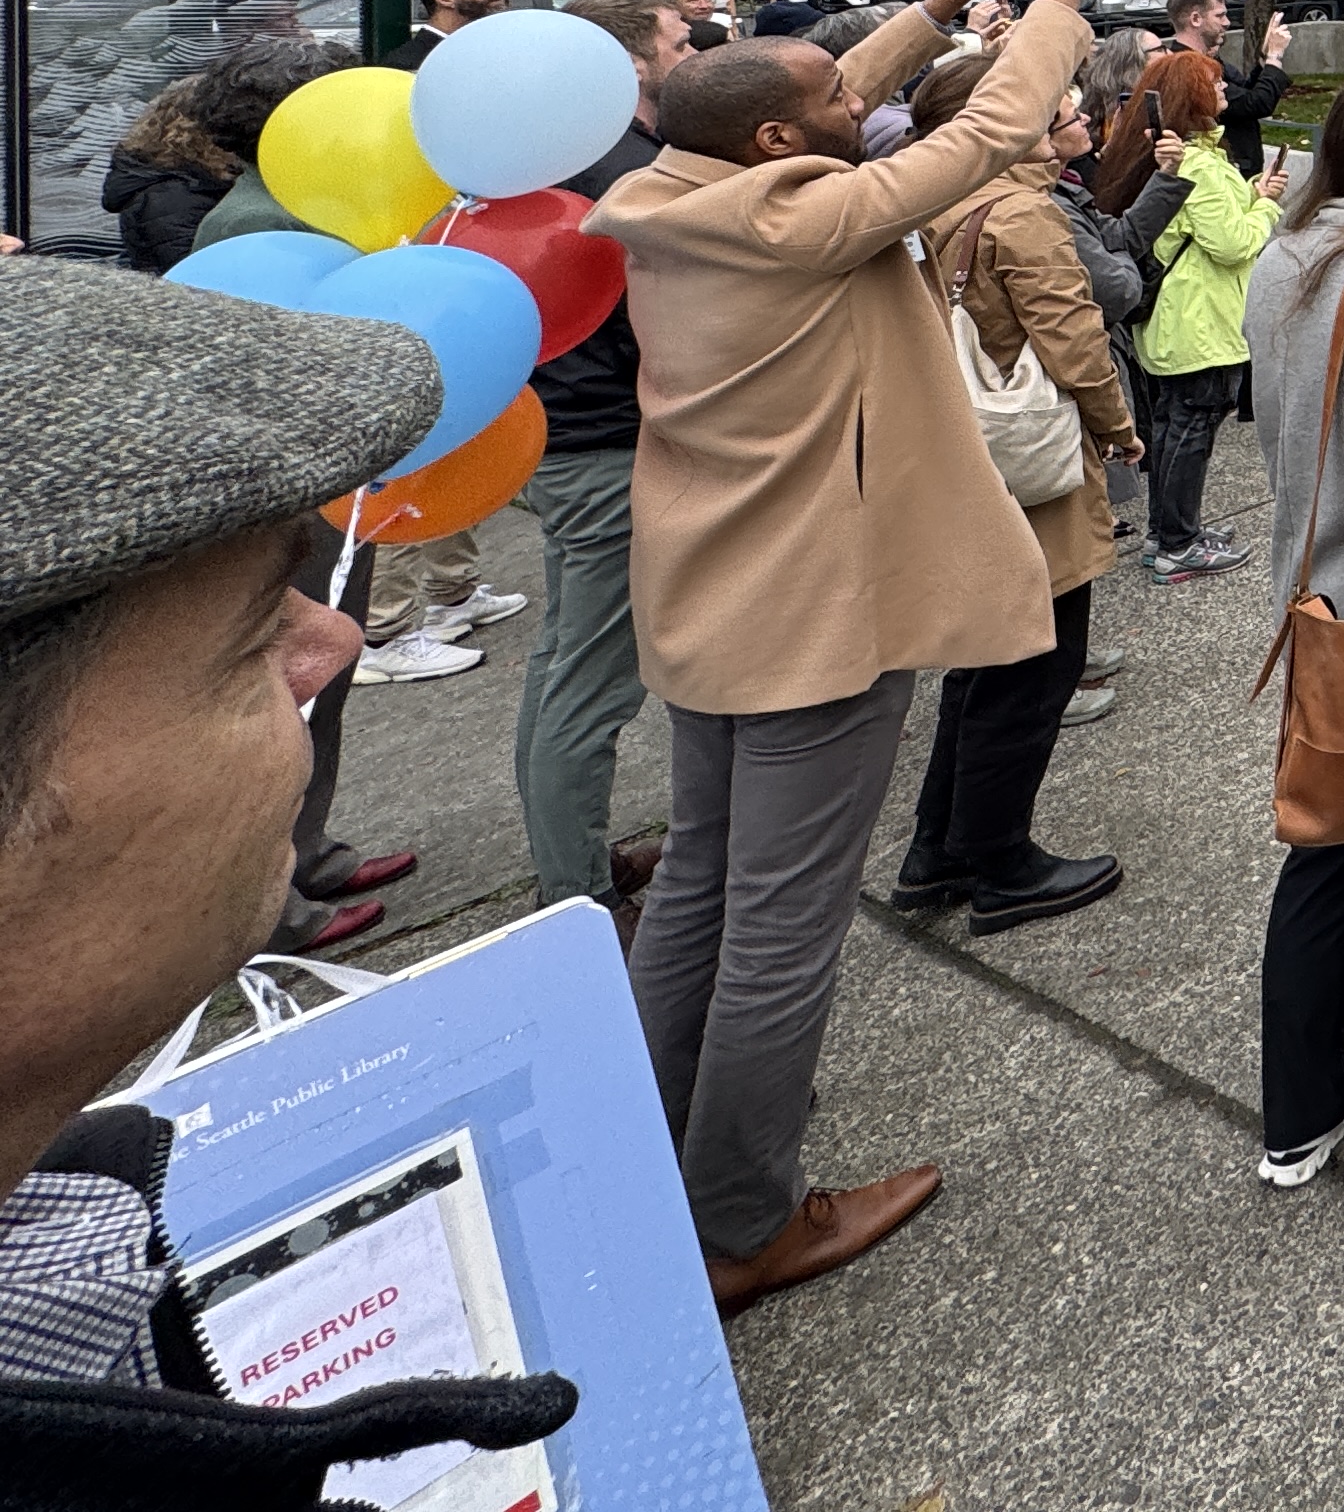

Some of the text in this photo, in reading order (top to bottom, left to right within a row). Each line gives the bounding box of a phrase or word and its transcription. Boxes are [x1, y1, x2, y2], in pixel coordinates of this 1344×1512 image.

[196, 1110, 267, 1151] Seattle
[271, 1076, 335, 1116] Public
[341, 1042, 411, 1084] Library
[240, 1286, 399, 1387] RESERVED
[261, 1327, 397, 1407] PARKING
